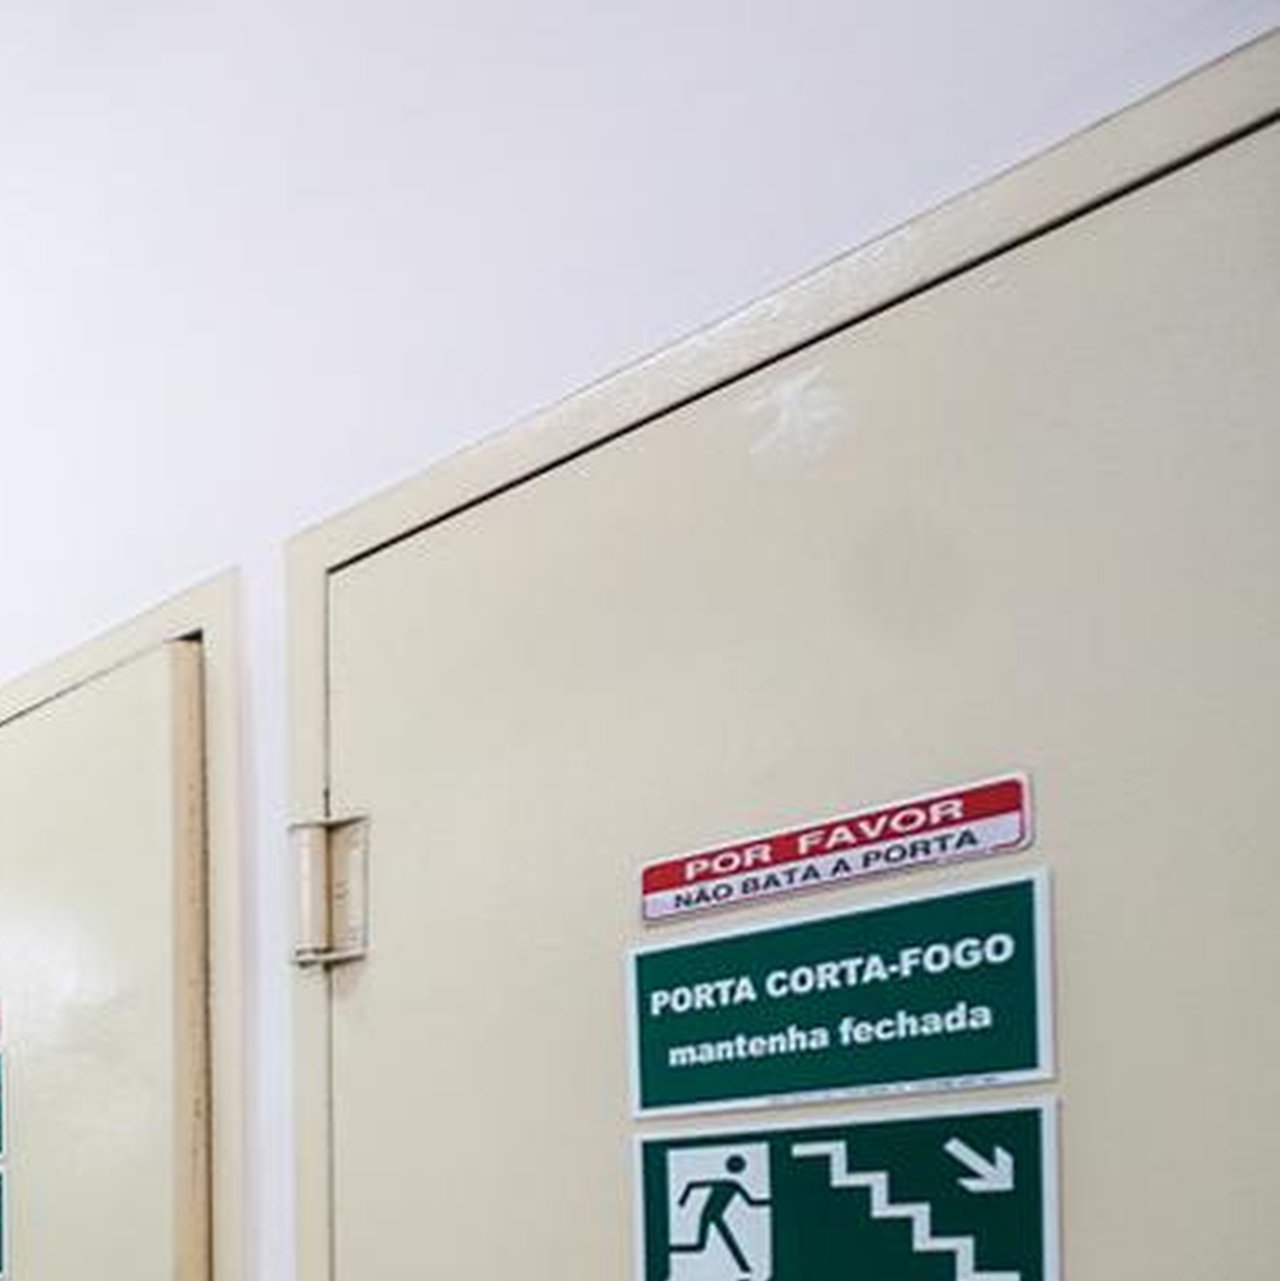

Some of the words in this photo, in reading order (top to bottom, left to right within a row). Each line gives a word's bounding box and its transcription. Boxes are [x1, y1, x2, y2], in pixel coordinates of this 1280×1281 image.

[673, 883, 734, 908] NÃO
[741, 864, 821, 894] BATA
[831, 858, 852, 876] A
[862, 829, 978, 868] PORTA
[684, 843, 772, 882] POR
[797, 799, 965, 855] FAVOR
[650, 975, 758, 1016] PORTA
[765, 933, 1015, 998] CORTA-FOGO
[668, 1023, 831, 1067] mantenha
[838, 1001, 993, 1046] fechada
